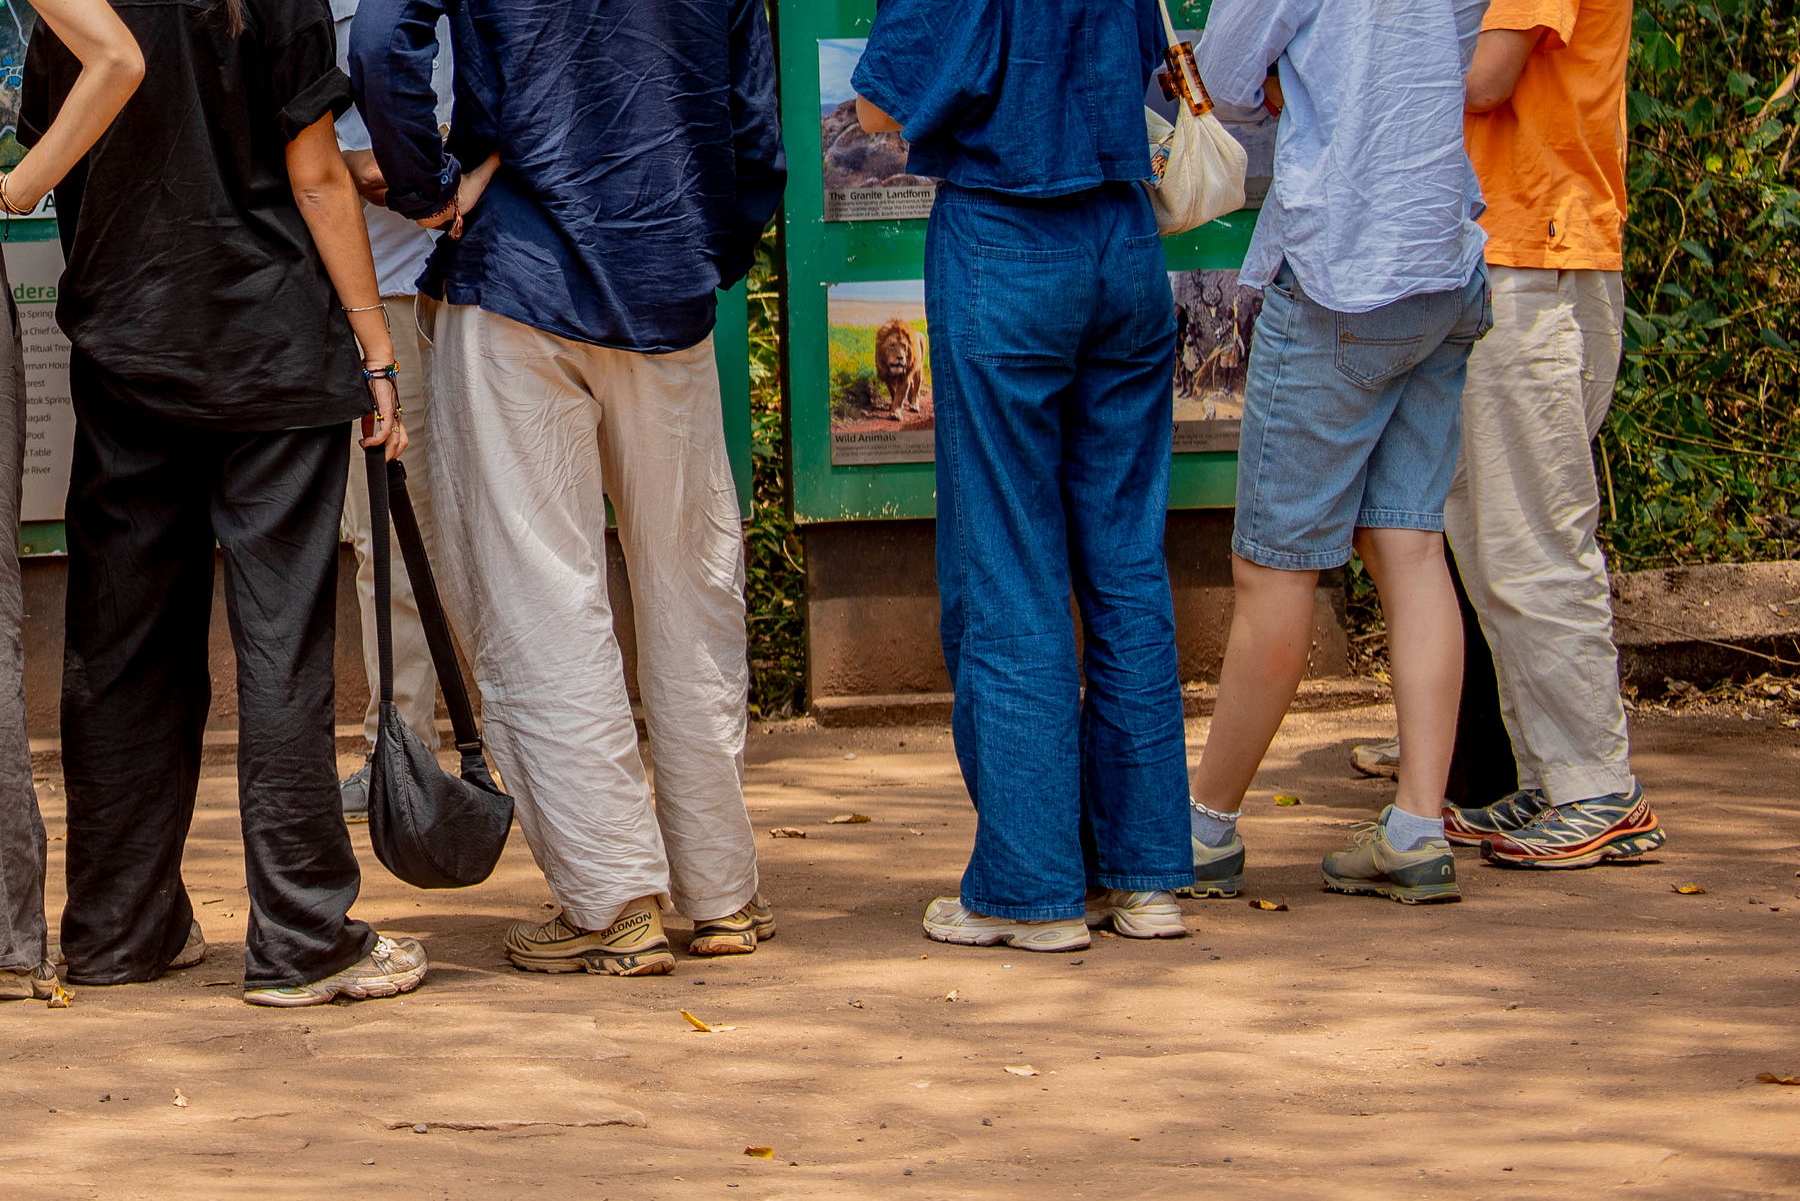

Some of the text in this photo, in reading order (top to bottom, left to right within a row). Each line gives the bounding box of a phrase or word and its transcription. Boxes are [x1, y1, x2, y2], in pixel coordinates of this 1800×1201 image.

[829, 190, 930, 200] The Granite Landform
[13, 283, 57, 299] dera
[27, 309, 53, 320] Spring
[29, 326, 49, 336] Chief
[30, 344, 52, 353] Ritual
[25, 361, 69, 370] rman Hous
[25, 380, 45, 388] orest
[45, 396, 71, 406] Spring
[27, 414, 51, 423] agadi
[26, 431, 45, 439] Pool
[835, 433, 897, 443] Wild Animals
[30, 448, 51, 457] Table
[31, 466, 51, 475] River
[601, 912, 651, 940] SALOMON
